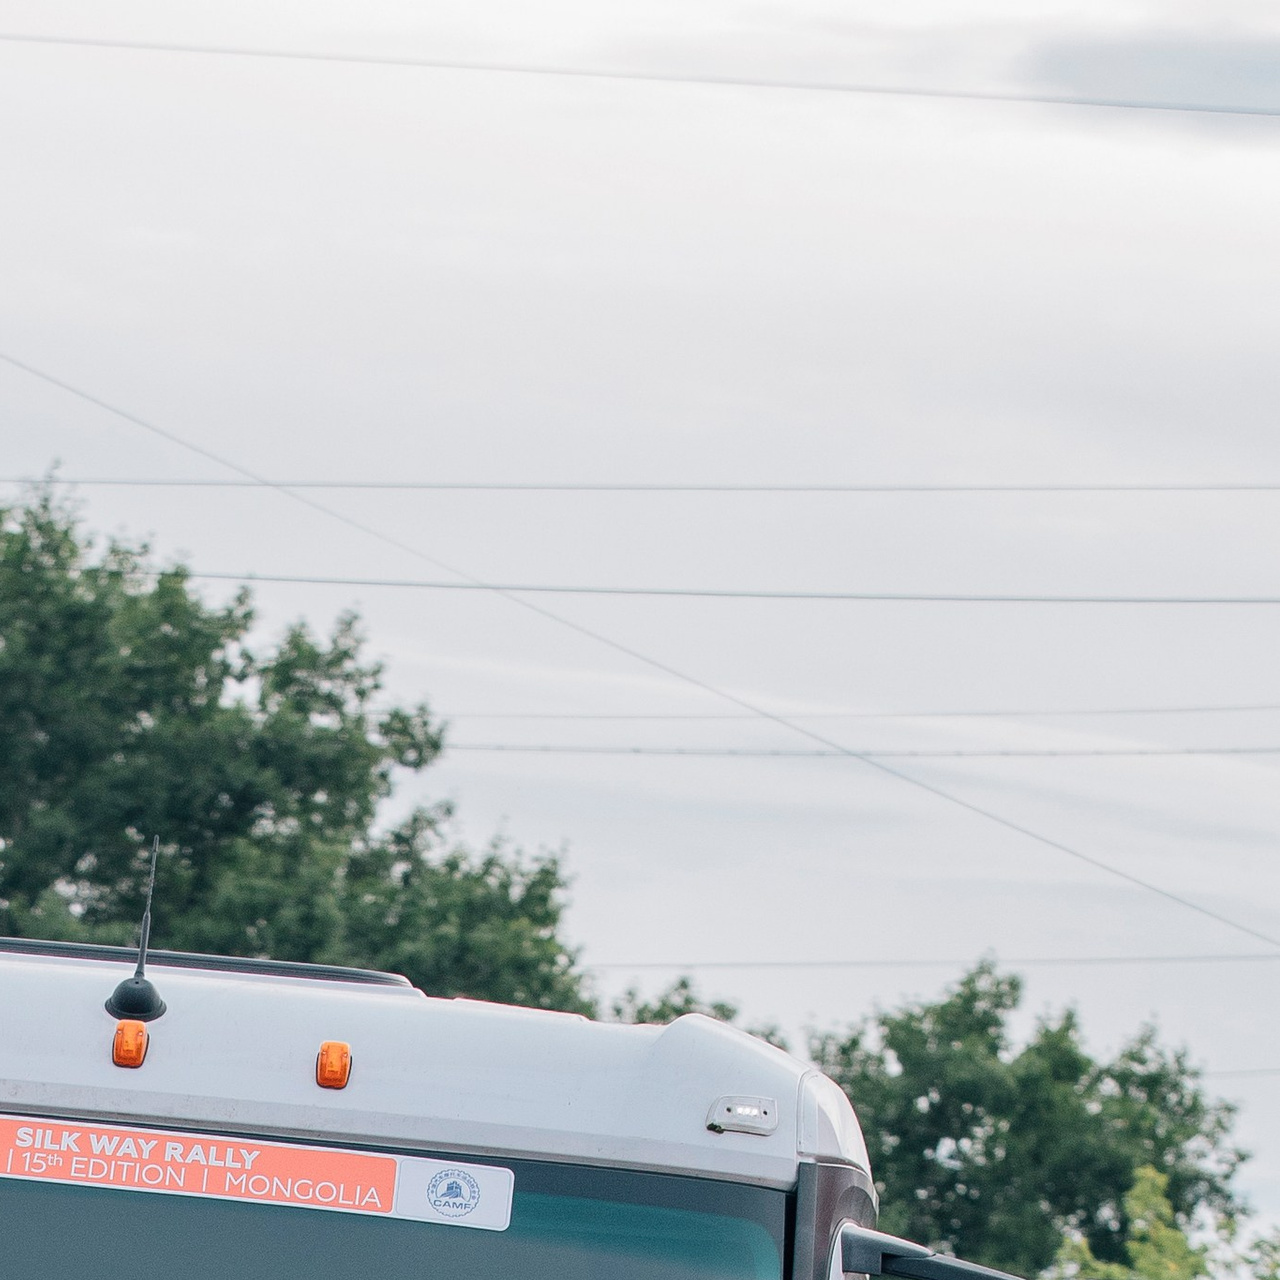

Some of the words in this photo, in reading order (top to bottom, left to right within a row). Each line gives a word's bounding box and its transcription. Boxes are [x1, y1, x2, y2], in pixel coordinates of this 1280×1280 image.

[15, 1127, 81, 1152] SILK
[89, 1135, 158, 1159] WAY
[164, 1142, 260, 1169] RALLY
[21, 1152, 63, 1173] 15th
[70, 1157, 186, 1187] EDITION
[224, 1172, 382, 1207] MONGOLIA
[433, 1200, 472, 1210] CAMF
